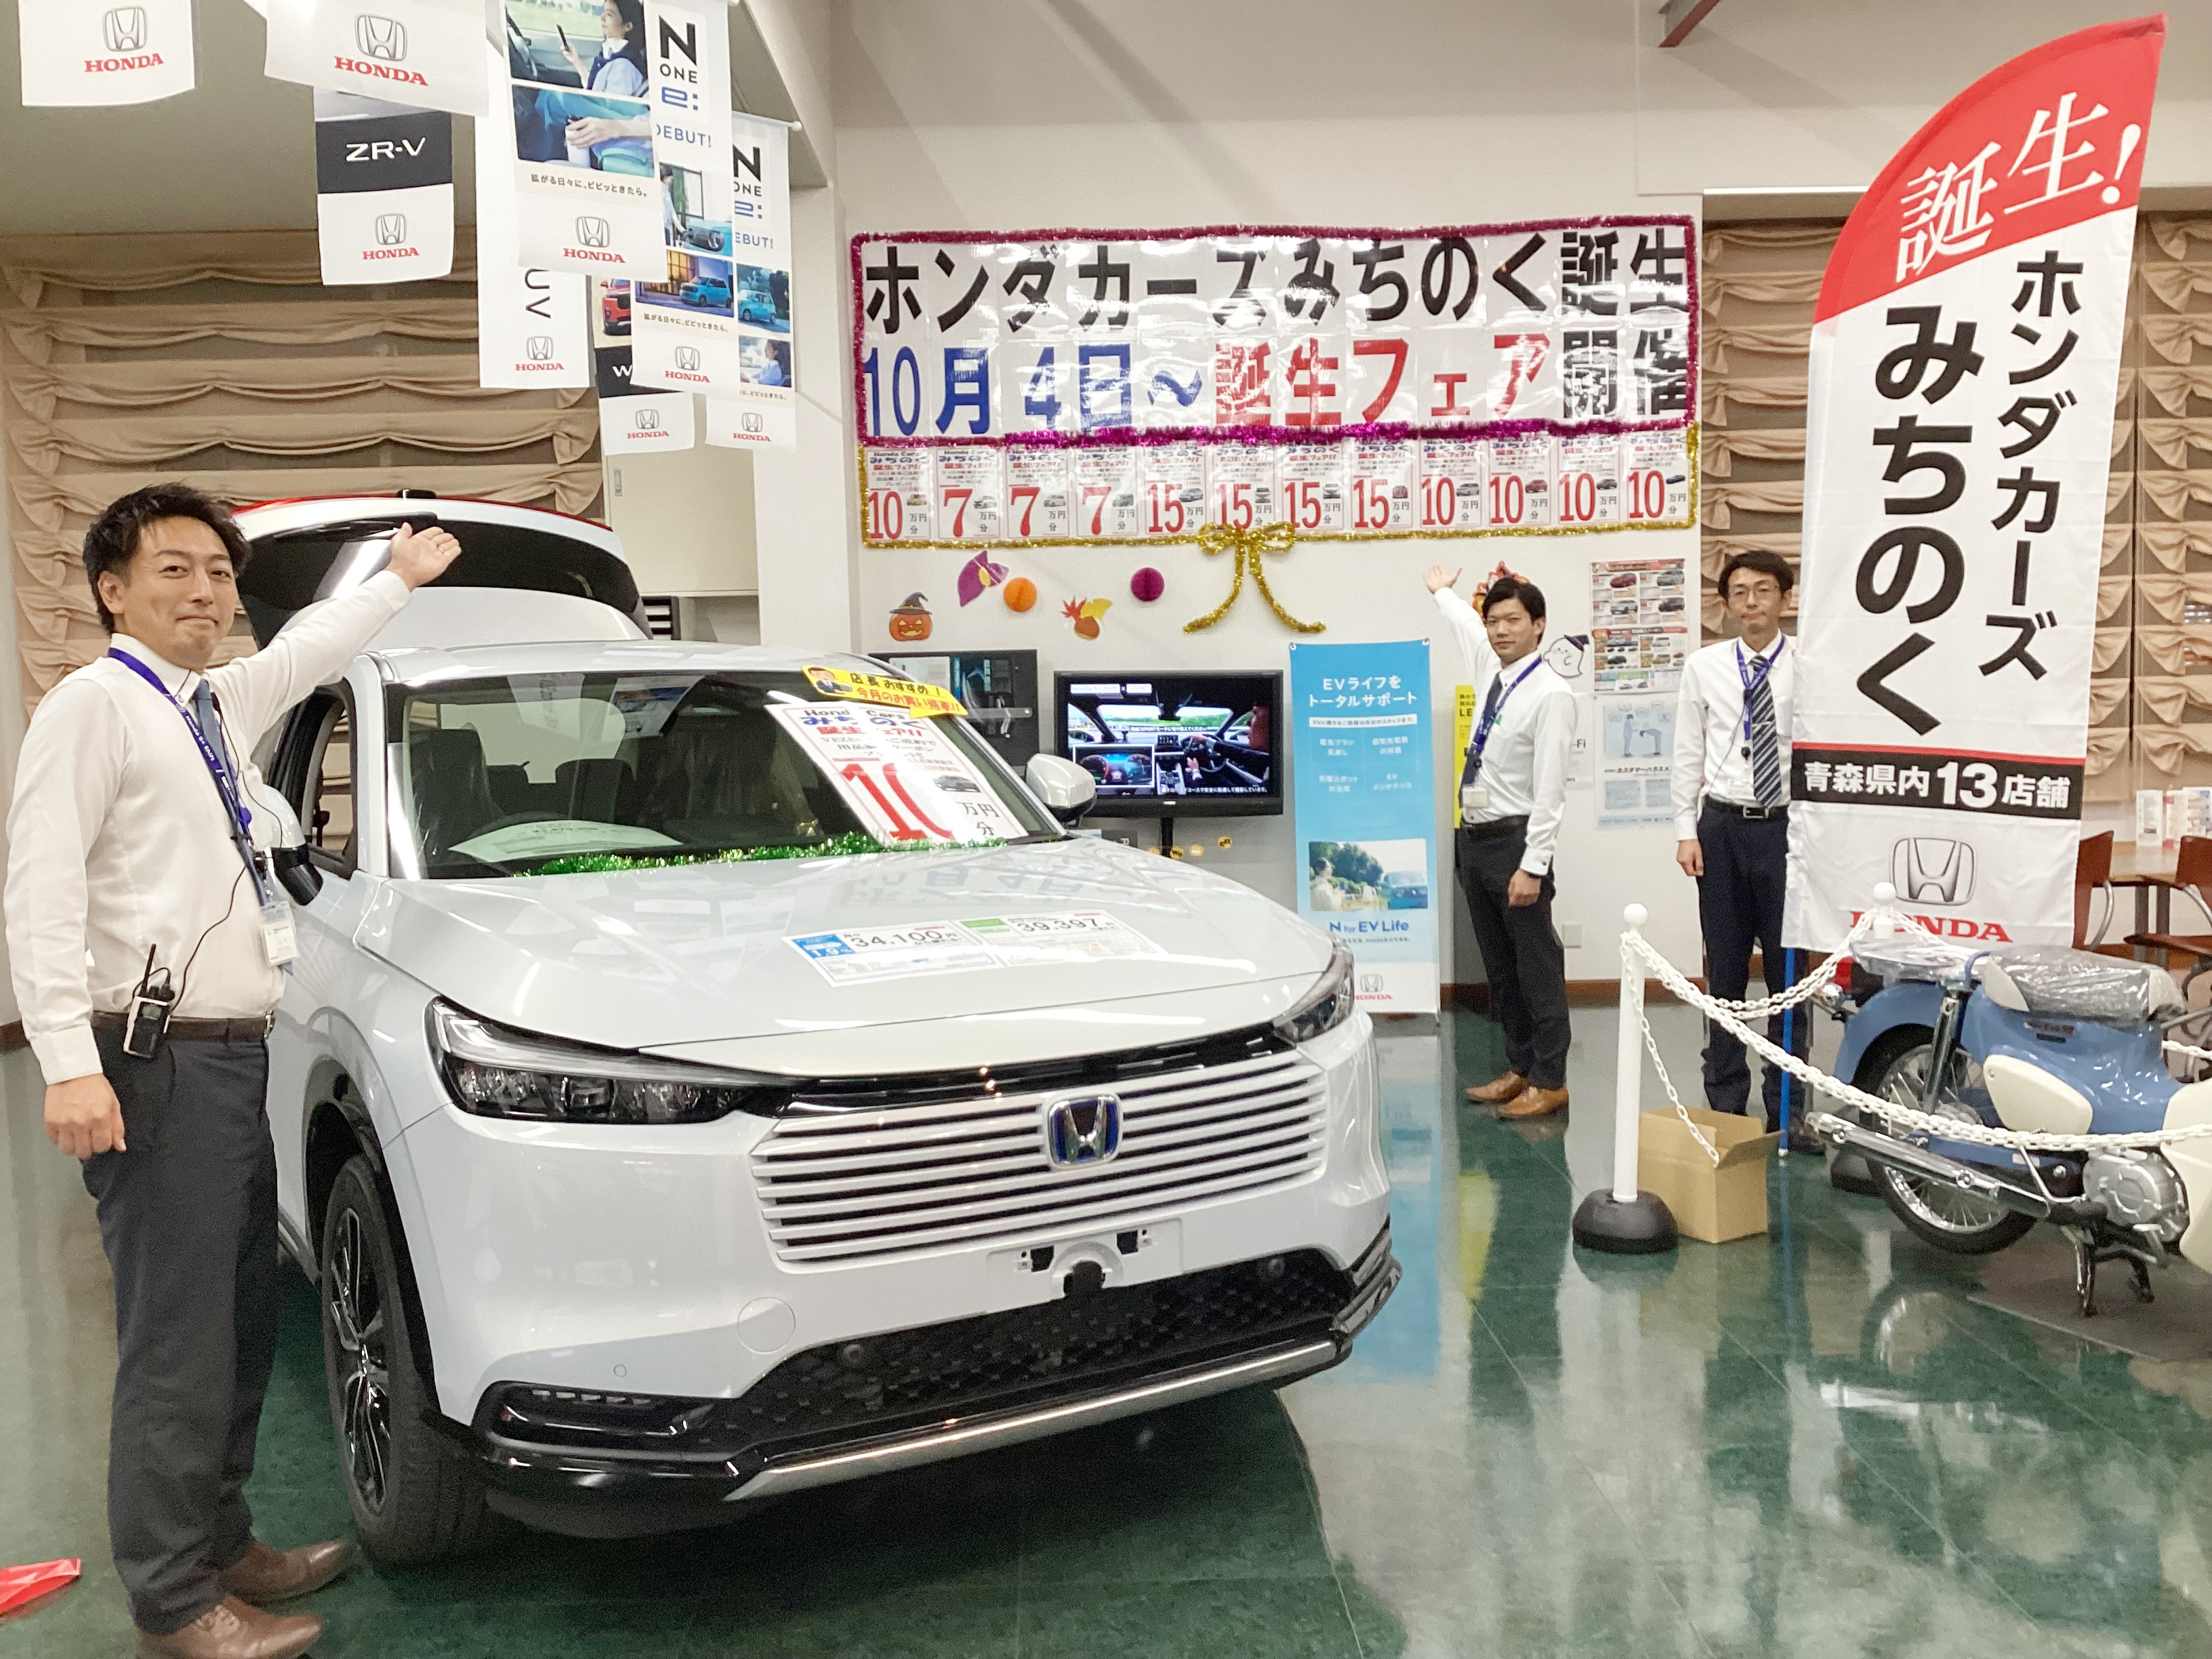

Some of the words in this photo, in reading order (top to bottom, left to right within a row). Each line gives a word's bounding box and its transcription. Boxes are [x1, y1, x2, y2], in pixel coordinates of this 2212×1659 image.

[659, 14, 697, 66] N
[84, 53, 164, 73] HONDA
[333, 56, 429, 86] HONDA
[659, 63, 698, 84] ONE
[345, 137, 426, 162] ZR-V
[1895, 91, 2142, 283] 誕生!
[735, 232, 774, 249] EBUT!
[362, 247, 419, 260] HONDA
[563, 248, 626, 264] HONDA
[865, 227, 1688, 335] ホンダカーズみちのく誕生
[515, 363, 565, 371] HONDA
[665, 369, 711, 384] HONDA
[627, 430, 670, 439] HONDA
[733, 432, 772, 442] HONDA
[1978, 249, 2084, 680] ホンダカーズ
[1422, 476, 1456, 525] 10
[1490, 475, 1524, 524] 10
[1559, 472, 1596, 521] 10
[1600, 495, 1617, 505] 万円
[1628, 470, 1665, 518] 10
[1669, 493, 1686, 501] 万円
[1147, 483, 1185, 533] 15
[1216, 483, 1253, 530] 15
[1284, 481, 1322, 529] 15
[1324, 503, 1340, 512] 万円
[1353, 478, 1390, 528] 15
[1393, 501, 1410, 510] 万円
[1461, 501, 1478, 509] 万円
[1532, 498, 1548, 507] 万円
[868, 491, 903, 539] 10
[943, 489, 973, 537] 7
[980, 511, 997, 520] 万円
[1010, 487, 1041, 537] 7
[1049, 510, 1066, 519] 万円
[1082, 486, 1112, 535] 7
[1118, 509, 1134, 518] 万円
[1187, 507, 1203, 515] 万円
[1255, 505, 1272, 514] 万円
[1530, 510, 1538, 520] 分
[1599, 508, 1607, 518] 分
[1668, 506, 1677, 514] 分
[909, 513, 927, 522] 万円
[1255, 517, 1263, 526] 分
[1324, 515, 1332, 524] 分
[1393, 514, 1401, 523] 分
[1462, 512, 1470, 521] 分
[1855, 304, 1985, 737] みちのく
[910, 526, 918, 534] 分
[980, 524, 987, 533] 分
[1049, 523, 1057, 532] 分
[1118, 521, 1126, 530] 分
[1187, 519, 1195, 528] 分
[1323, 675, 1401, 691] EVライフを
[1309, 691, 1418, 708] トータルサポート
[867, 710, 905, 719] Cars
[816, 726, 923, 737] 誕生ェア!!
[1804, 760, 2072, 810] 青森県内13店舗
[957, 802, 1000, 817] 万円
[977, 821, 994, 836] 分
[1330, 921, 1341, 933] N
[1359, 921, 1378, 933] EV
[1382, 920, 1410, 932] Life
[1849, 910, 2013, 943] NDA
